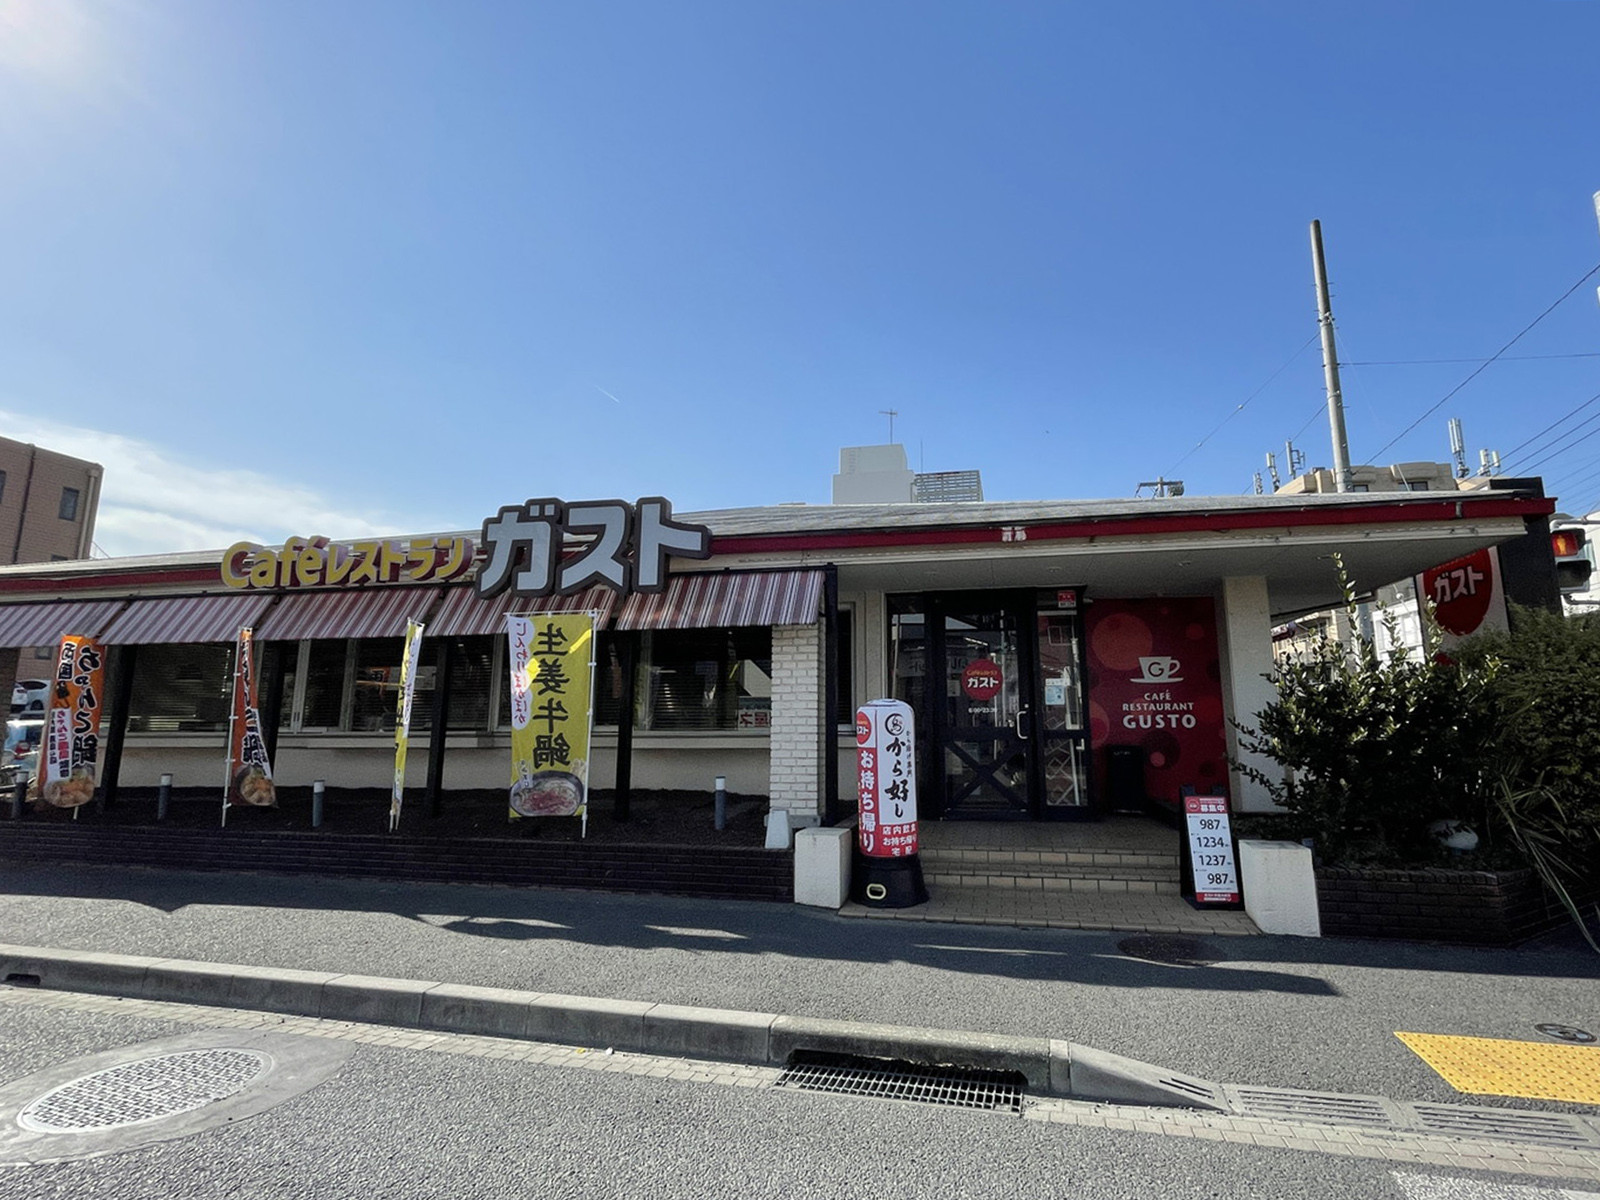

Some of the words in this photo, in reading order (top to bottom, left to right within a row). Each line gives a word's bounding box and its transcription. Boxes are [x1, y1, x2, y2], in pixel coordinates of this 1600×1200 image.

[475, 497, 711, 598] ガスト
[221, 535, 467, 588] Caféレストラン
[1434, 565, 1483, 603] ガスト
[1148, 662, 1164, 677] G
[967, 677, 999, 688] ガスト
[1144, 689, 1172, 701] CAFÉ
[1122, 702, 1195, 712] RESTAURANT
[1122, 714, 1196, 729] GUSTO
[885, 737, 909, 818] から好し
[860, 750, 876, 852] お持ち帰り
[883, 823, 916, 835] 店内飲食
[1199, 819, 1220, 830] 987
[883, 834, 917, 846] お持ち帰り
[1196, 837, 1224, 848] 1234
[891, 846, 912, 856] 宅配
[1199, 855, 1226, 866] 1237
[1207, 873, 1228, 884] 987
